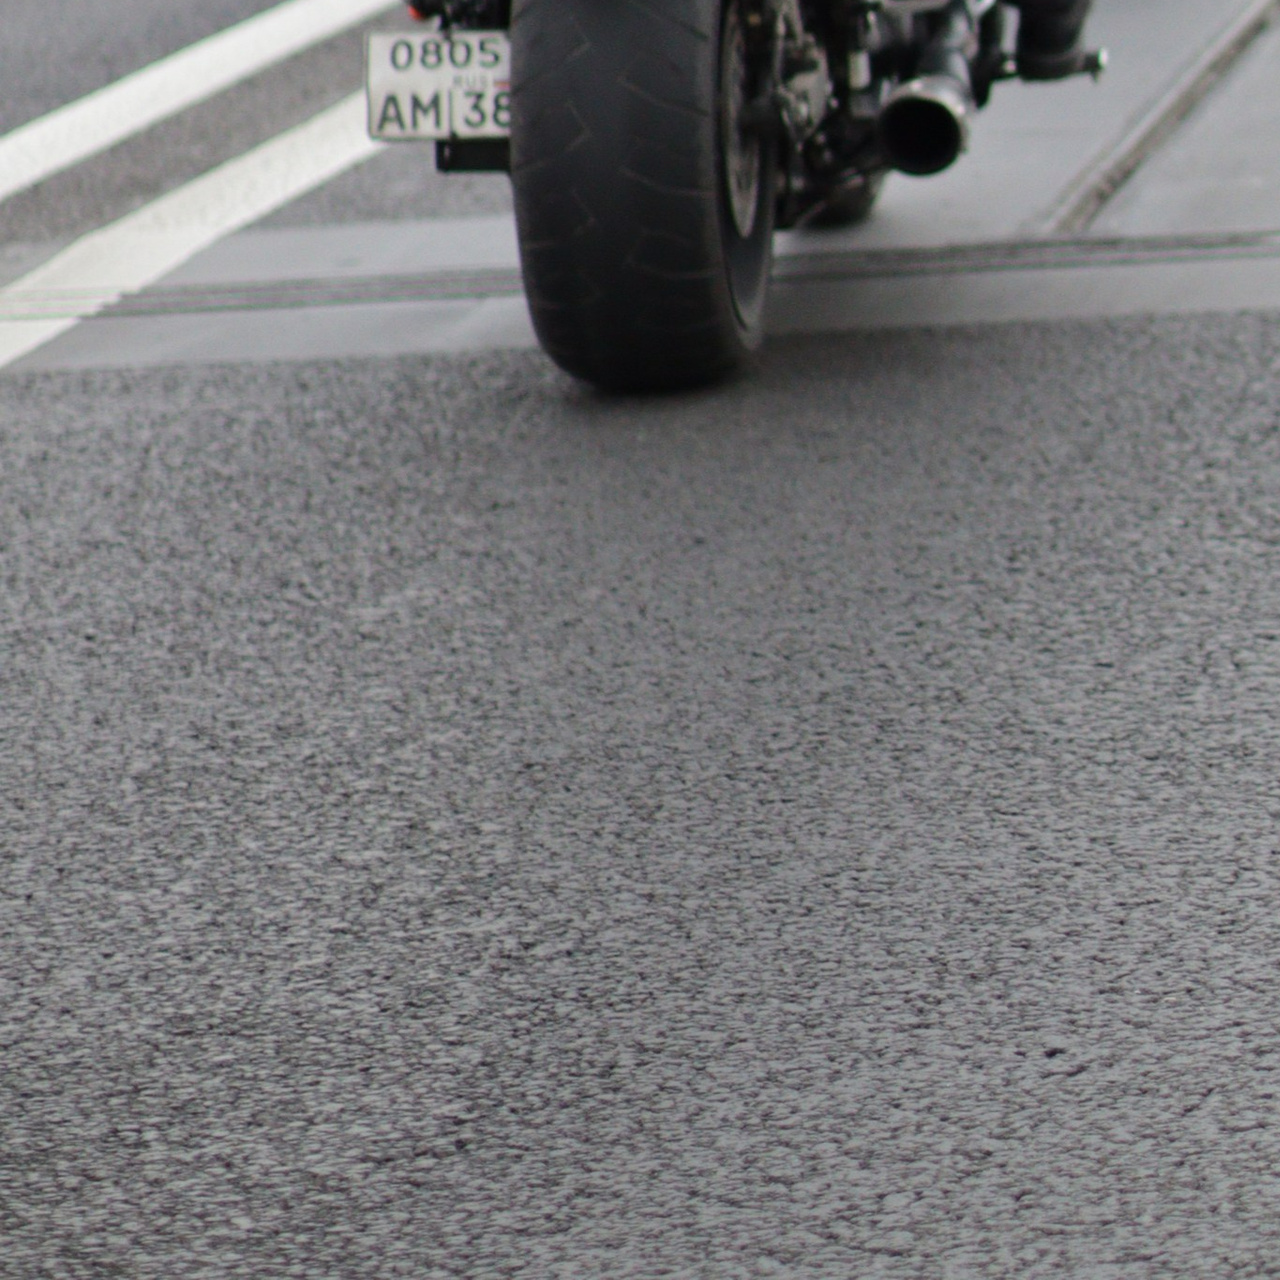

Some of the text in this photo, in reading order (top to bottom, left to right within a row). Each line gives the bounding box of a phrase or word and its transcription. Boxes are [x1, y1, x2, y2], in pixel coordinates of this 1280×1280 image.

[390, 38, 500, 71] 0805
[377, 91, 510, 132] AM 38
